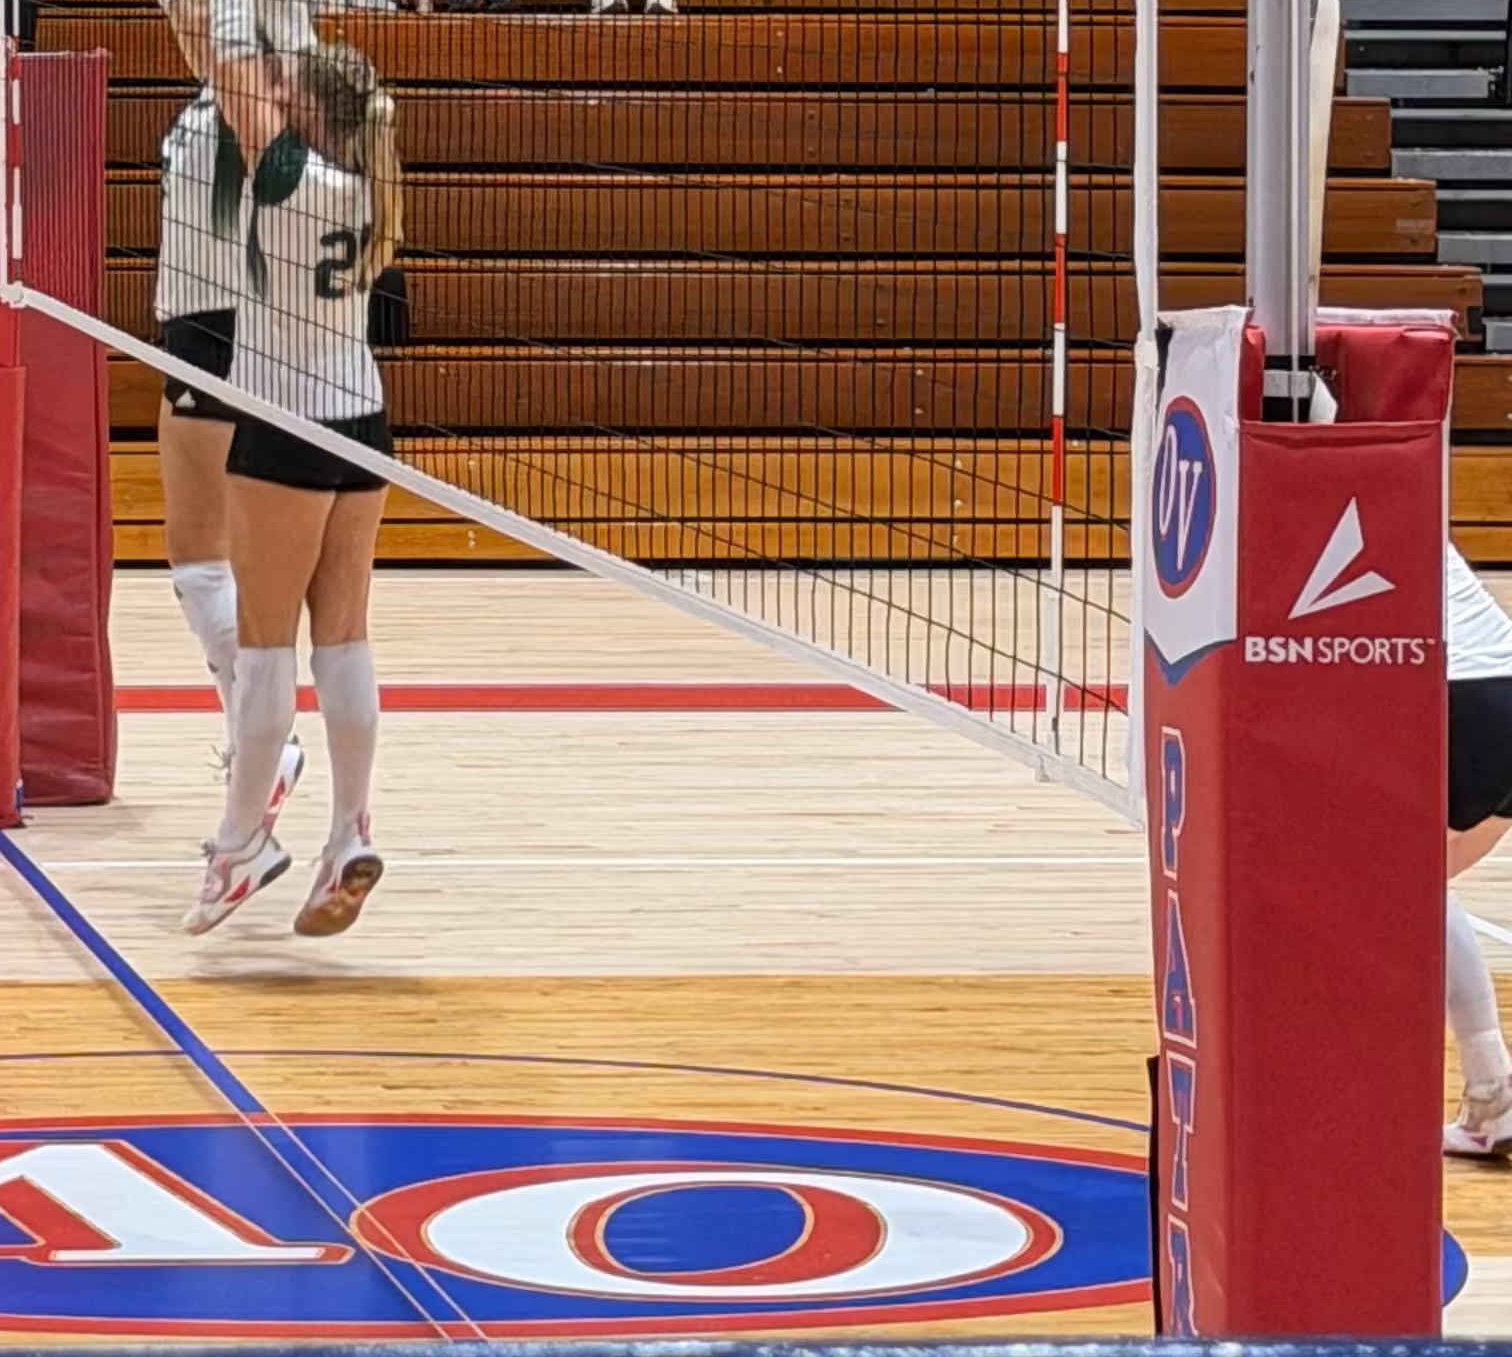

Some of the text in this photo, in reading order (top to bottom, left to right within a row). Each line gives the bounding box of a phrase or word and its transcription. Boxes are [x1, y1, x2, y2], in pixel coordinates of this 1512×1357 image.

[1158, 423, 1203, 572] OV
[1244, 635, 1426, 665] BSN SPORTS
